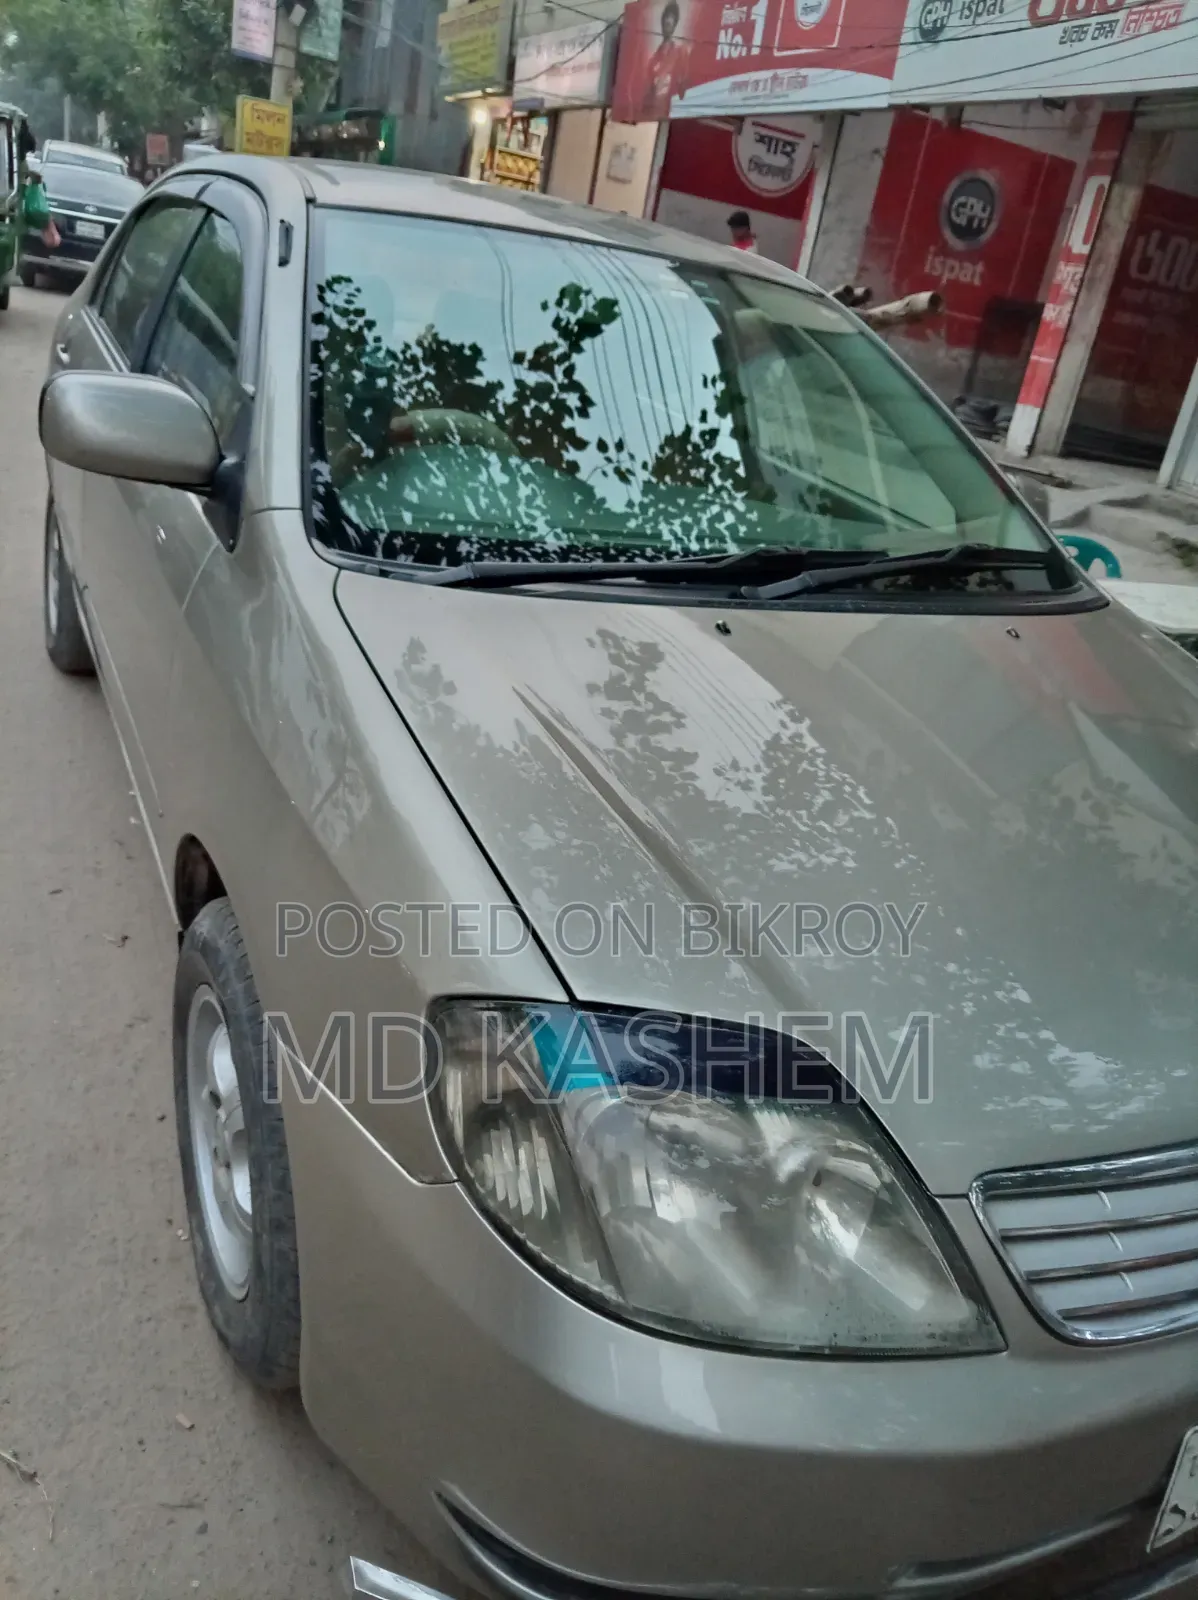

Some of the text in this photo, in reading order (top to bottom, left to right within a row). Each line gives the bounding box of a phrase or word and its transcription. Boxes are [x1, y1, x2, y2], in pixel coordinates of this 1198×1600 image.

[716, 27, 747, 60] No.
[950, 195, 992, 230] GPH
[923, 244, 985, 287] ispat
